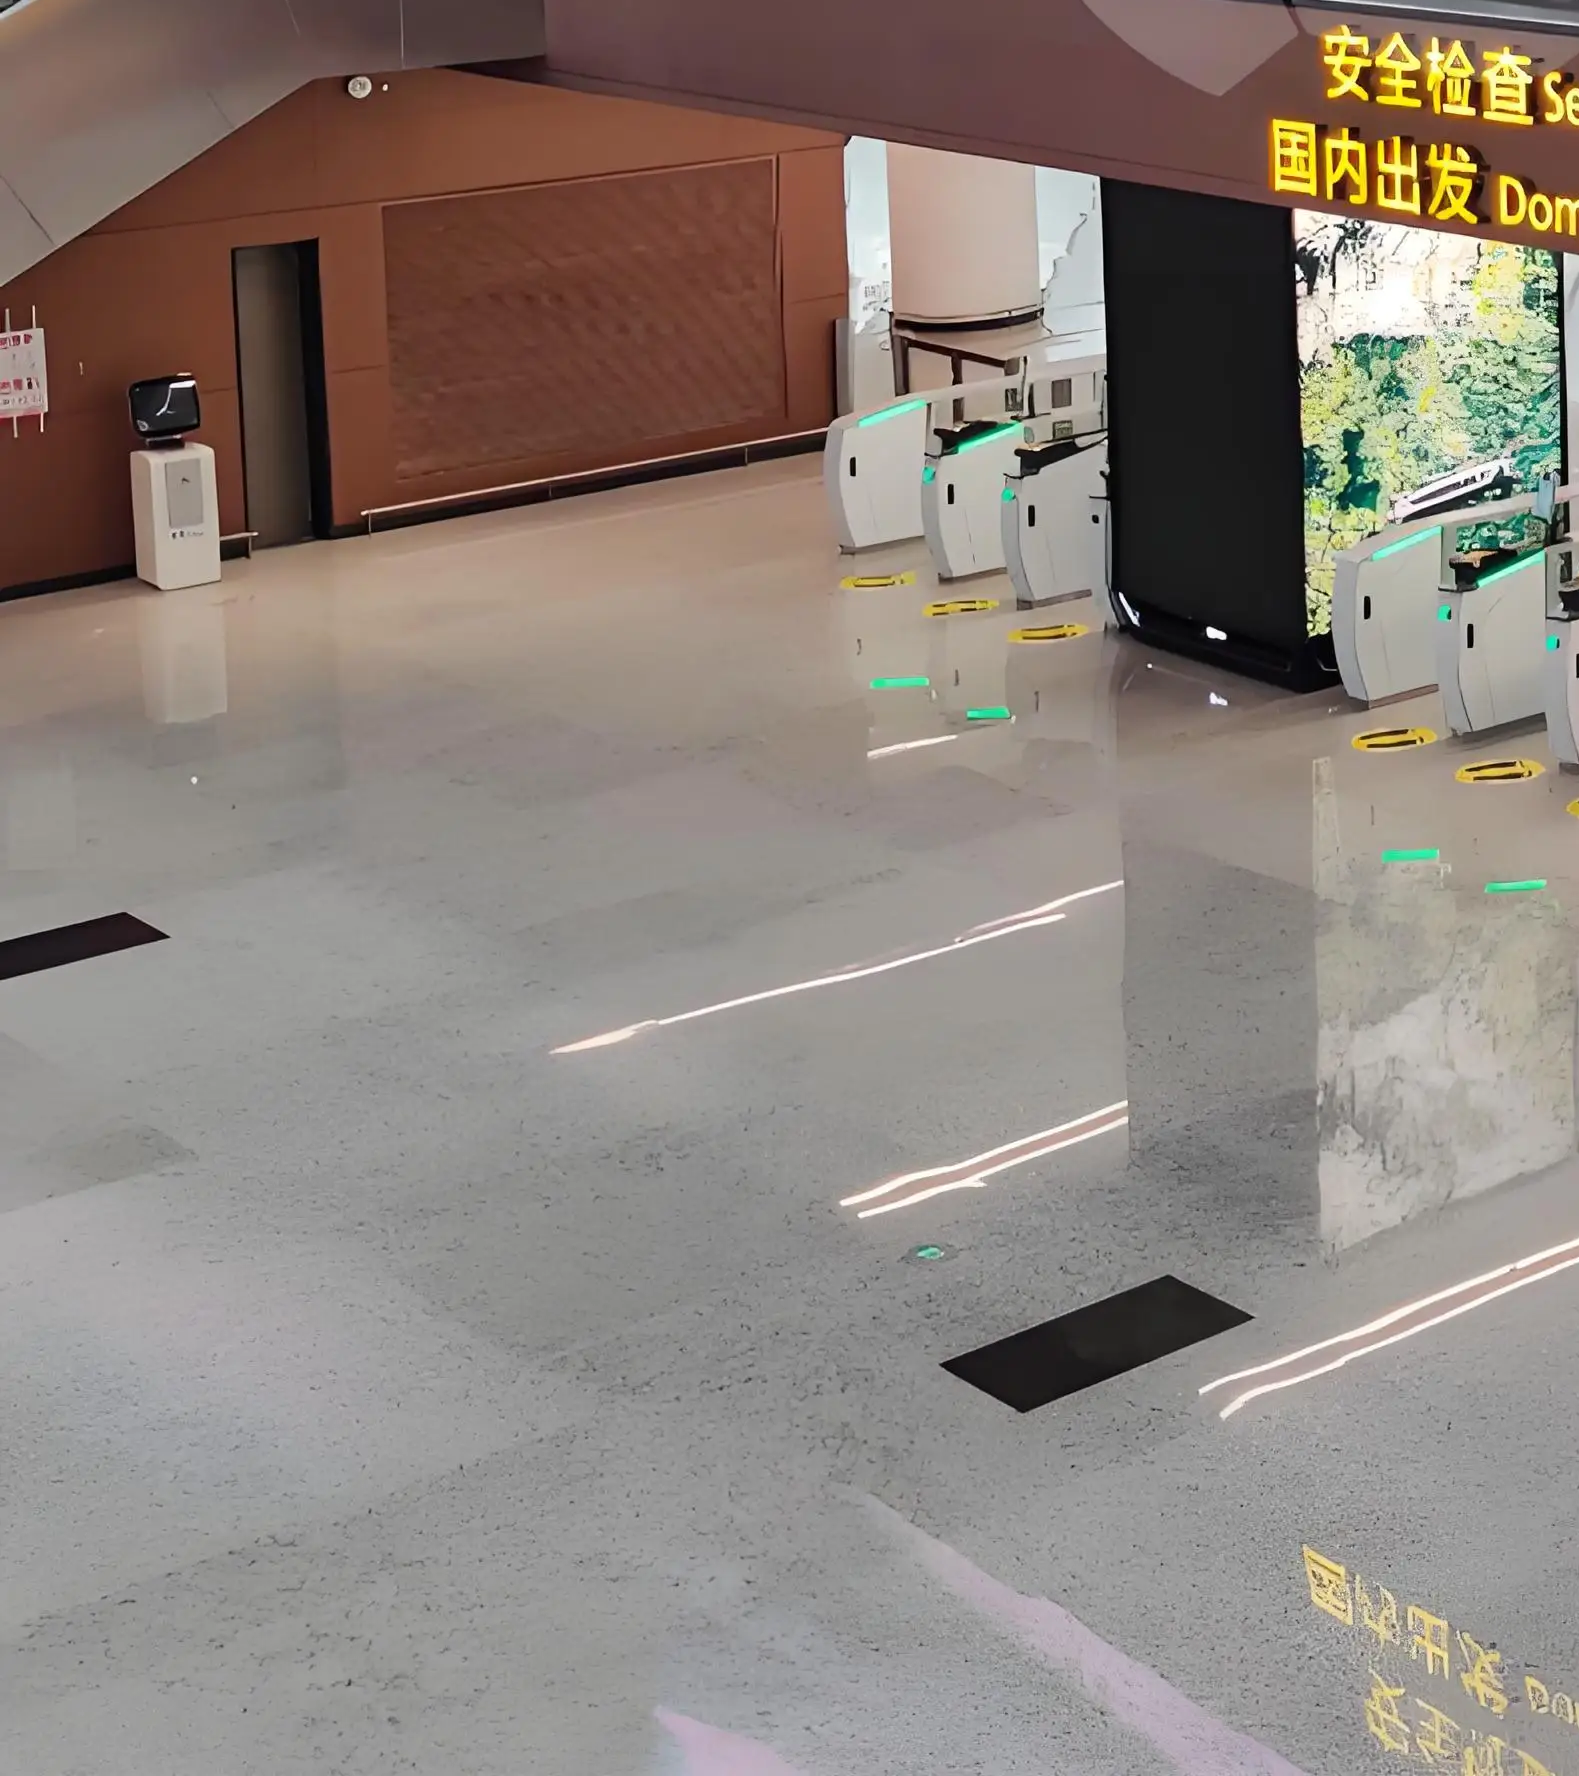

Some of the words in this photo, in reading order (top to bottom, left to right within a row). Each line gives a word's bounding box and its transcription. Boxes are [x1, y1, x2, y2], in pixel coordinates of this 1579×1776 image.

[1322, 24, 1534, 127] 安全检查
[1270, 117, 1479, 226] 国内出发
